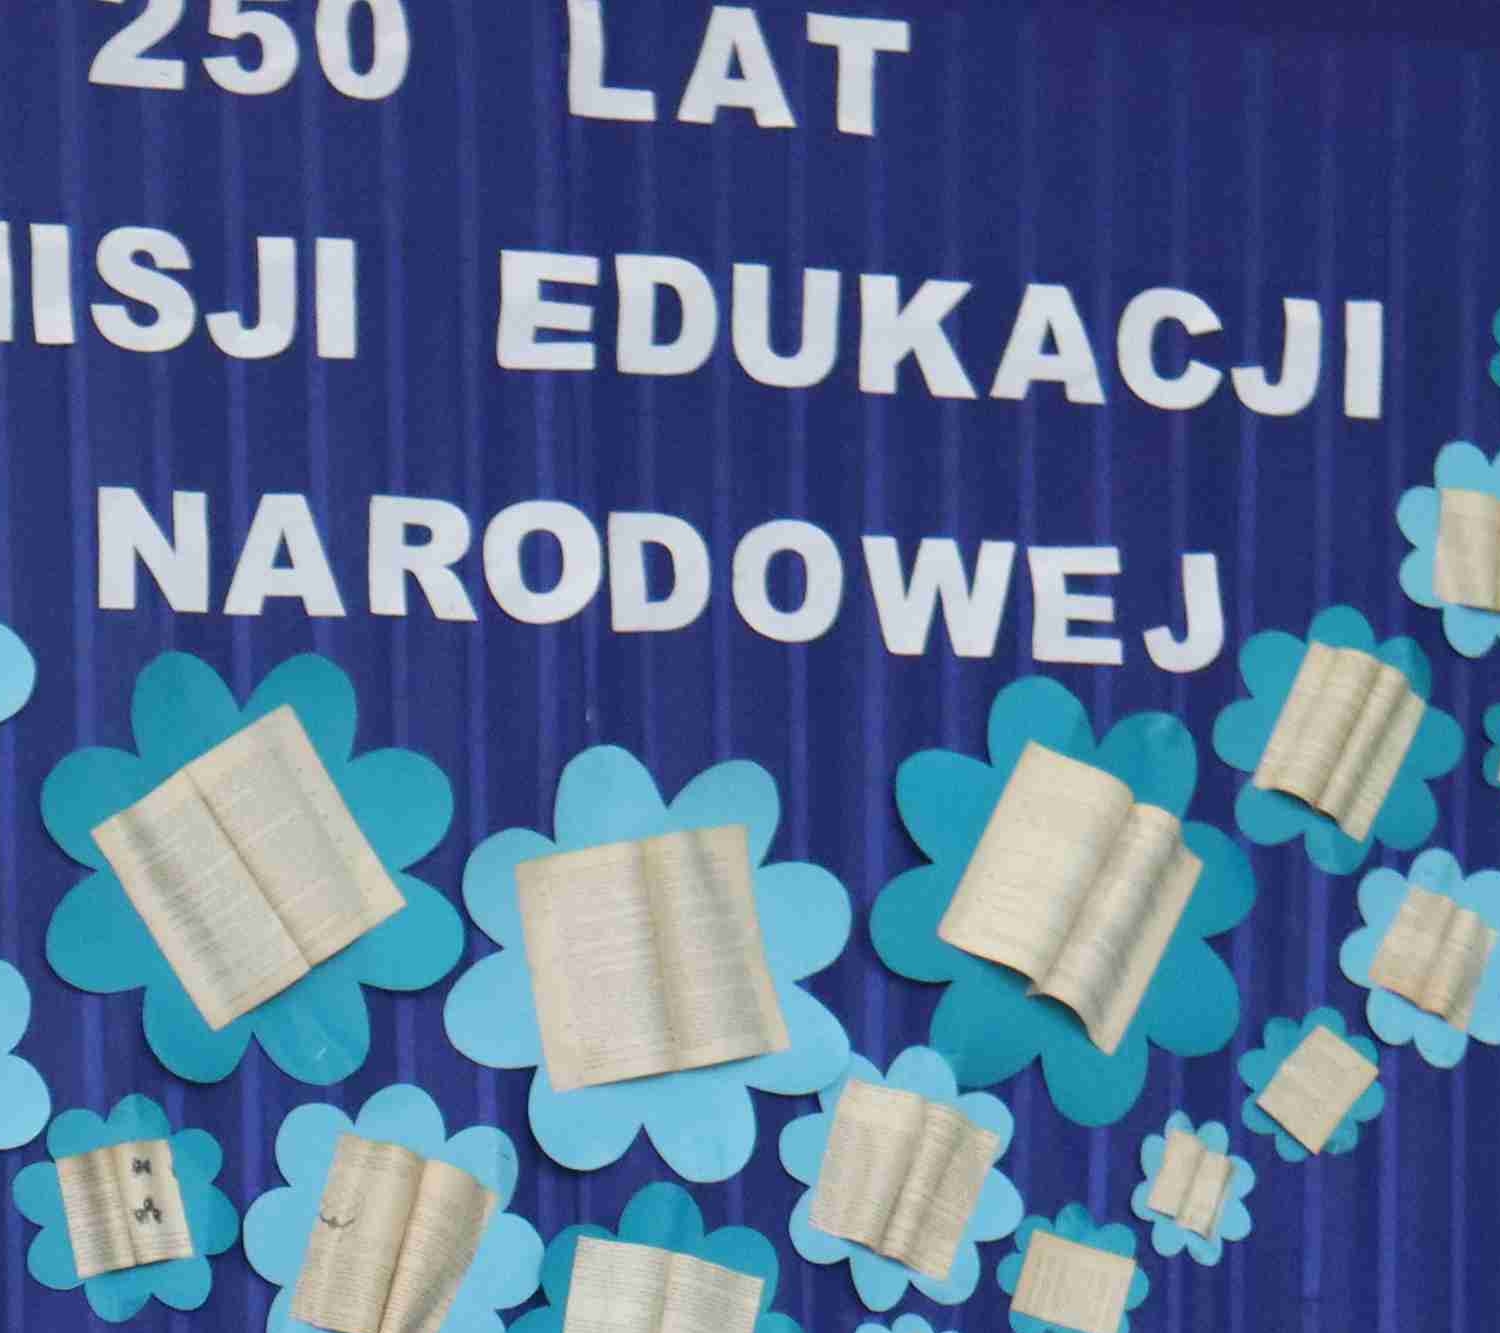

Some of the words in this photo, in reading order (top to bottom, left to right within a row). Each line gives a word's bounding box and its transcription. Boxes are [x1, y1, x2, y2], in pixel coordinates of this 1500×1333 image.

[88, 0, 409, 100] 250
[567, 0, 909, 136] LAT
[496, 250, 1382, 419] EDUKACJI
[98, 486, 1224, 673] NARODOWEJ
